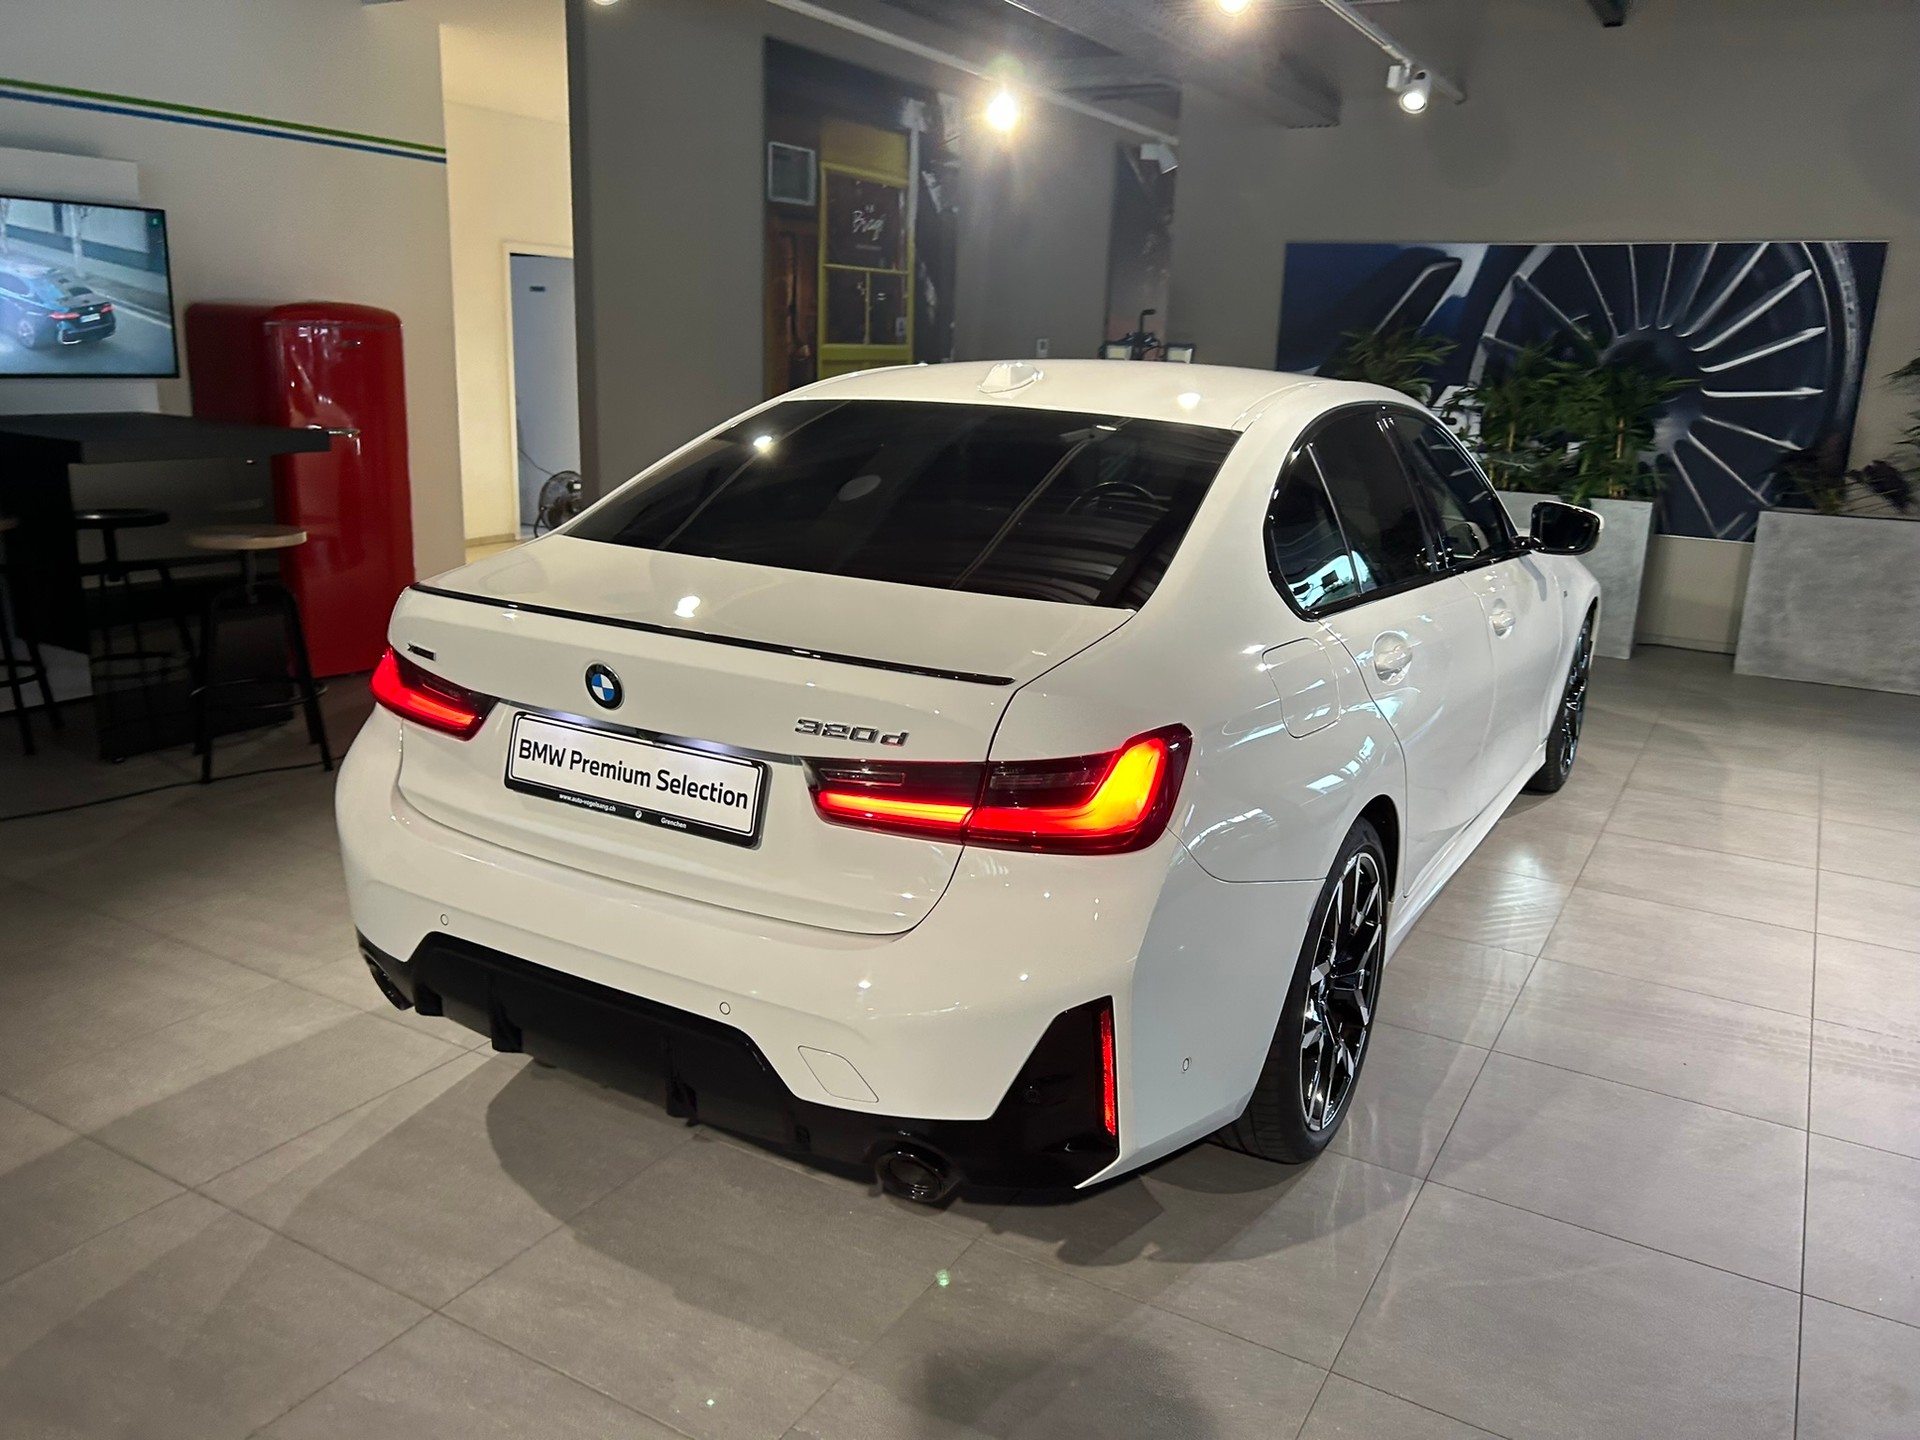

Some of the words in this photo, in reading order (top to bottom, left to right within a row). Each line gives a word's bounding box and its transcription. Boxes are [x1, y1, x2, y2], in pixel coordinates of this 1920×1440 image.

[794, 718, 910, 747] 320d
[519, 739, 567, 767] BMW
[570, 750, 651, 788] Premium
[656, 769, 748, 809] Selection
[559, 794, 616, 811] www.auto-vogelsang.ch
[660, 817, 687, 829] Grenchen
